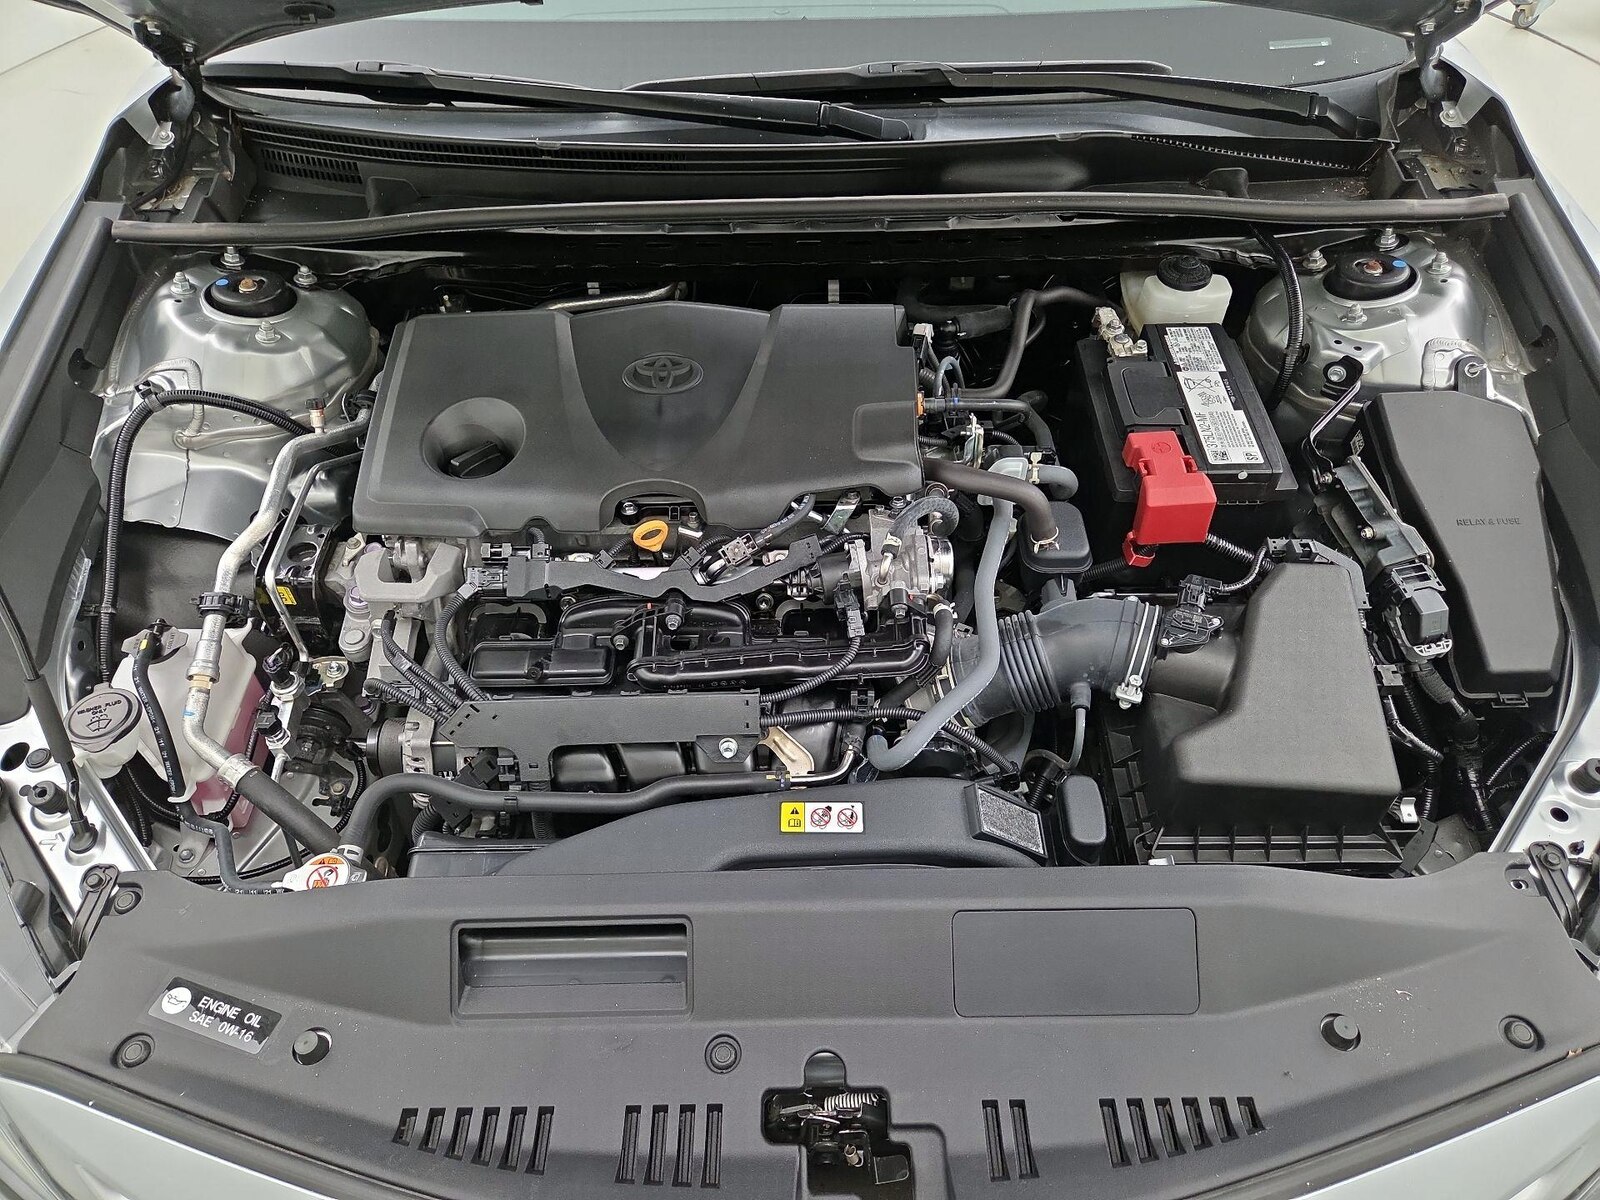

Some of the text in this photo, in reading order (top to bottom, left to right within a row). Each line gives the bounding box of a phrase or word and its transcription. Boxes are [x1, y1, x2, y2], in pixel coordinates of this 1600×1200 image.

[1245, 452, 1259, 461] SP
[1456, 518, 1485, 526] RELAY
[1497, 517, 1521, 525] FUSE
[77, 699, 122, 715] WASHER FLUID
[198, 996, 262, 1028] ENGINE OIL
[189, 1010, 254, 1043] SAE 0W-16
